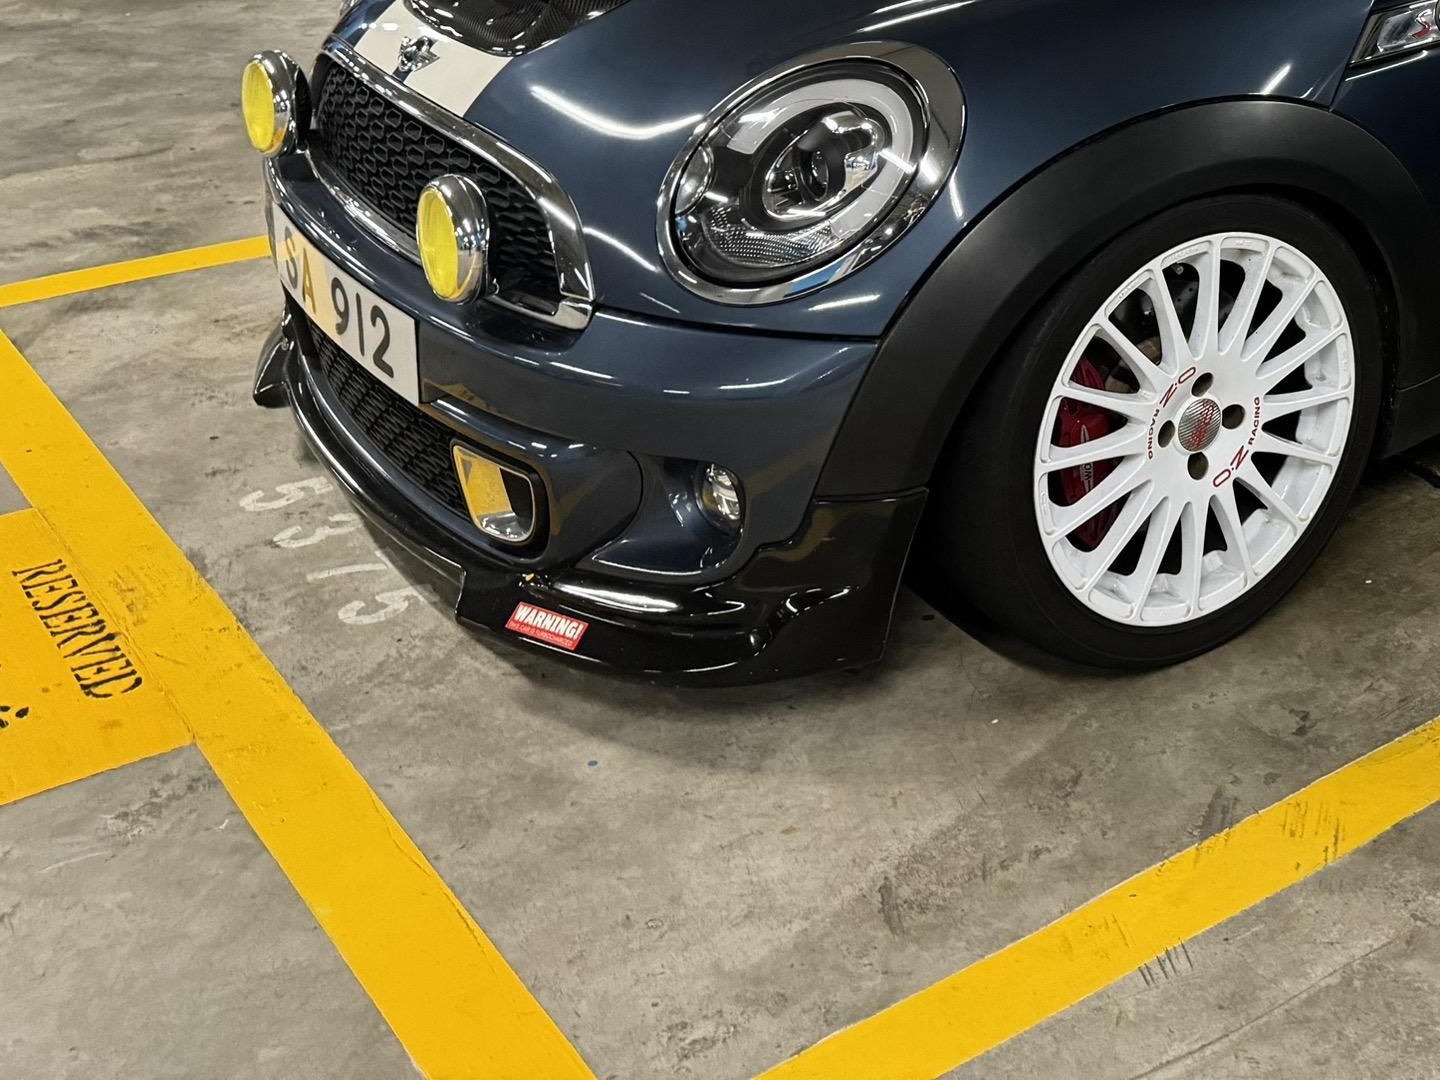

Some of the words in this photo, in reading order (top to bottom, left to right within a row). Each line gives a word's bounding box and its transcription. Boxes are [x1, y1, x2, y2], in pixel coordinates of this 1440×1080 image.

[284, 225, 317, 315] SA
[330, 276, 395, 379] 912
[1247, 396, 1261, 446] RACING
[12, 558, 143, 699] RESERVED
[514, 604, 585, 640] WARNING!
